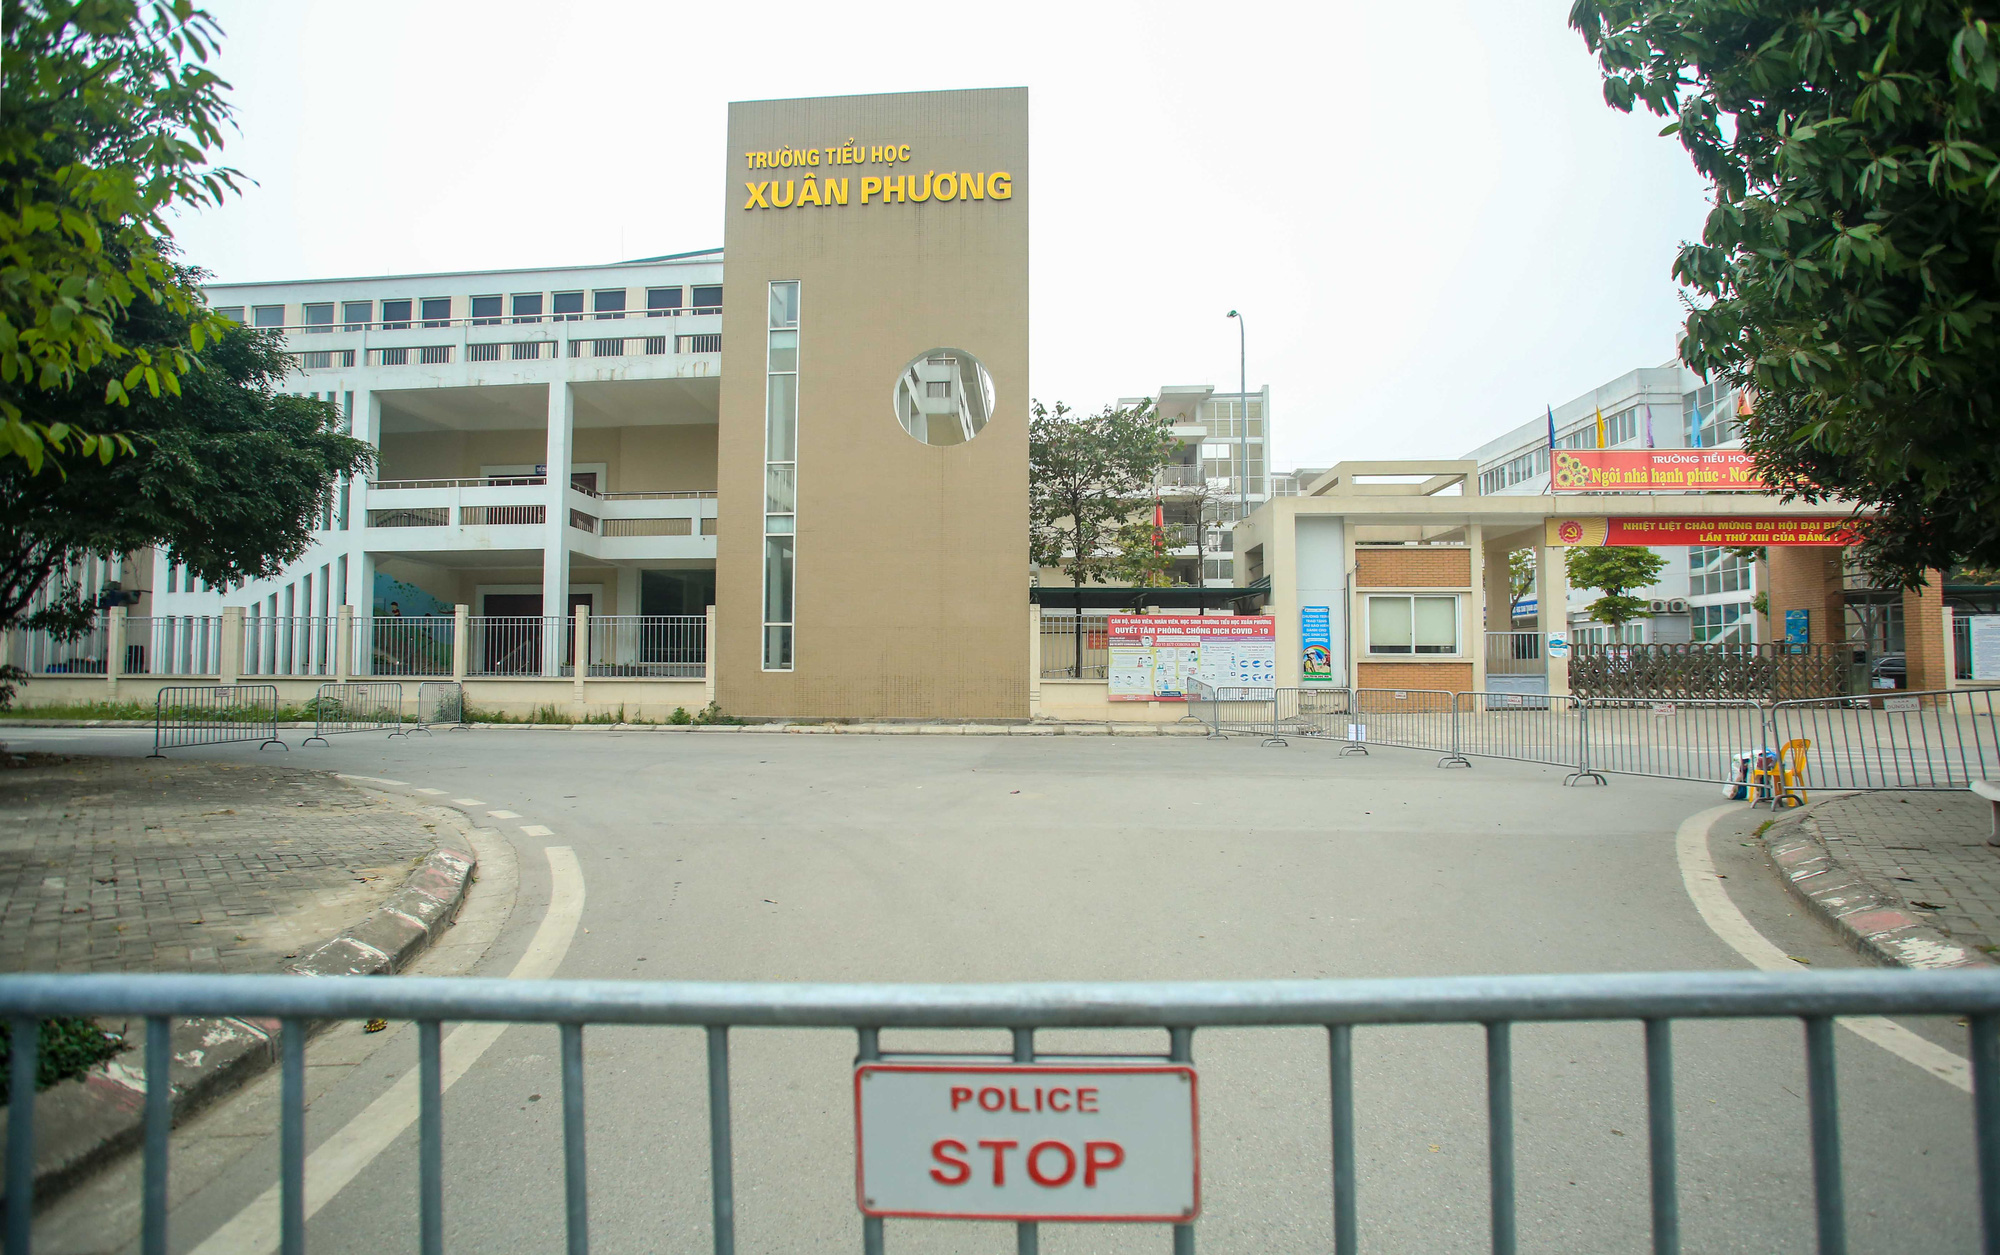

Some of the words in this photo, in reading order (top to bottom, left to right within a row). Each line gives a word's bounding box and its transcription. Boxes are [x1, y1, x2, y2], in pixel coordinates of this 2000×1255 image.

[745, 145, 820, 169] TRƯỜNG
[825, 138, 865, 165] TIỂU
[871, 144, 911, 167] HỌC
[744, 172, 849, 210] XUÂN
[861, 170, 1012, 204] PHƯƠNG
[1652, 453, 1699, 464] TRƯỜNG
[1702, 452, 1725, 463] TIỂU
[1728, 455, 1755, 464] HỌC
[1591, 467, 1621, 487] Ngôi
[1624, 466, 1648, 483] nhà
[1651, 467, 1684, 486] hạnh
[1687, 467, 1719, 486] phúc
[1623, 521, 1655, 531] NHIỆT
[1659, 521, 1681, 531] LIỆT
[1685, 520, 1715, 530] CHÀO
[1718, 520, 1752, 530] MỪNG
[1755, 522, 1774, 531] ĐẠI
[1778, 521, 1797, 531] HỘI
[1800, 522, 1820, 531] ĐẠI
[1725, 533, 1748, 542] THỨ
[1772, 531, 1795, 541] CỦA
[1115, 625, 1138, 634] QUYẾT
[1140, 626, 1155, 634] TÂM
[1186, 626, 1211, 634] CHỐNG
[951, 1087, 1099, 1112] POLICE
[930, 1139, 1125, 1187] STOP
